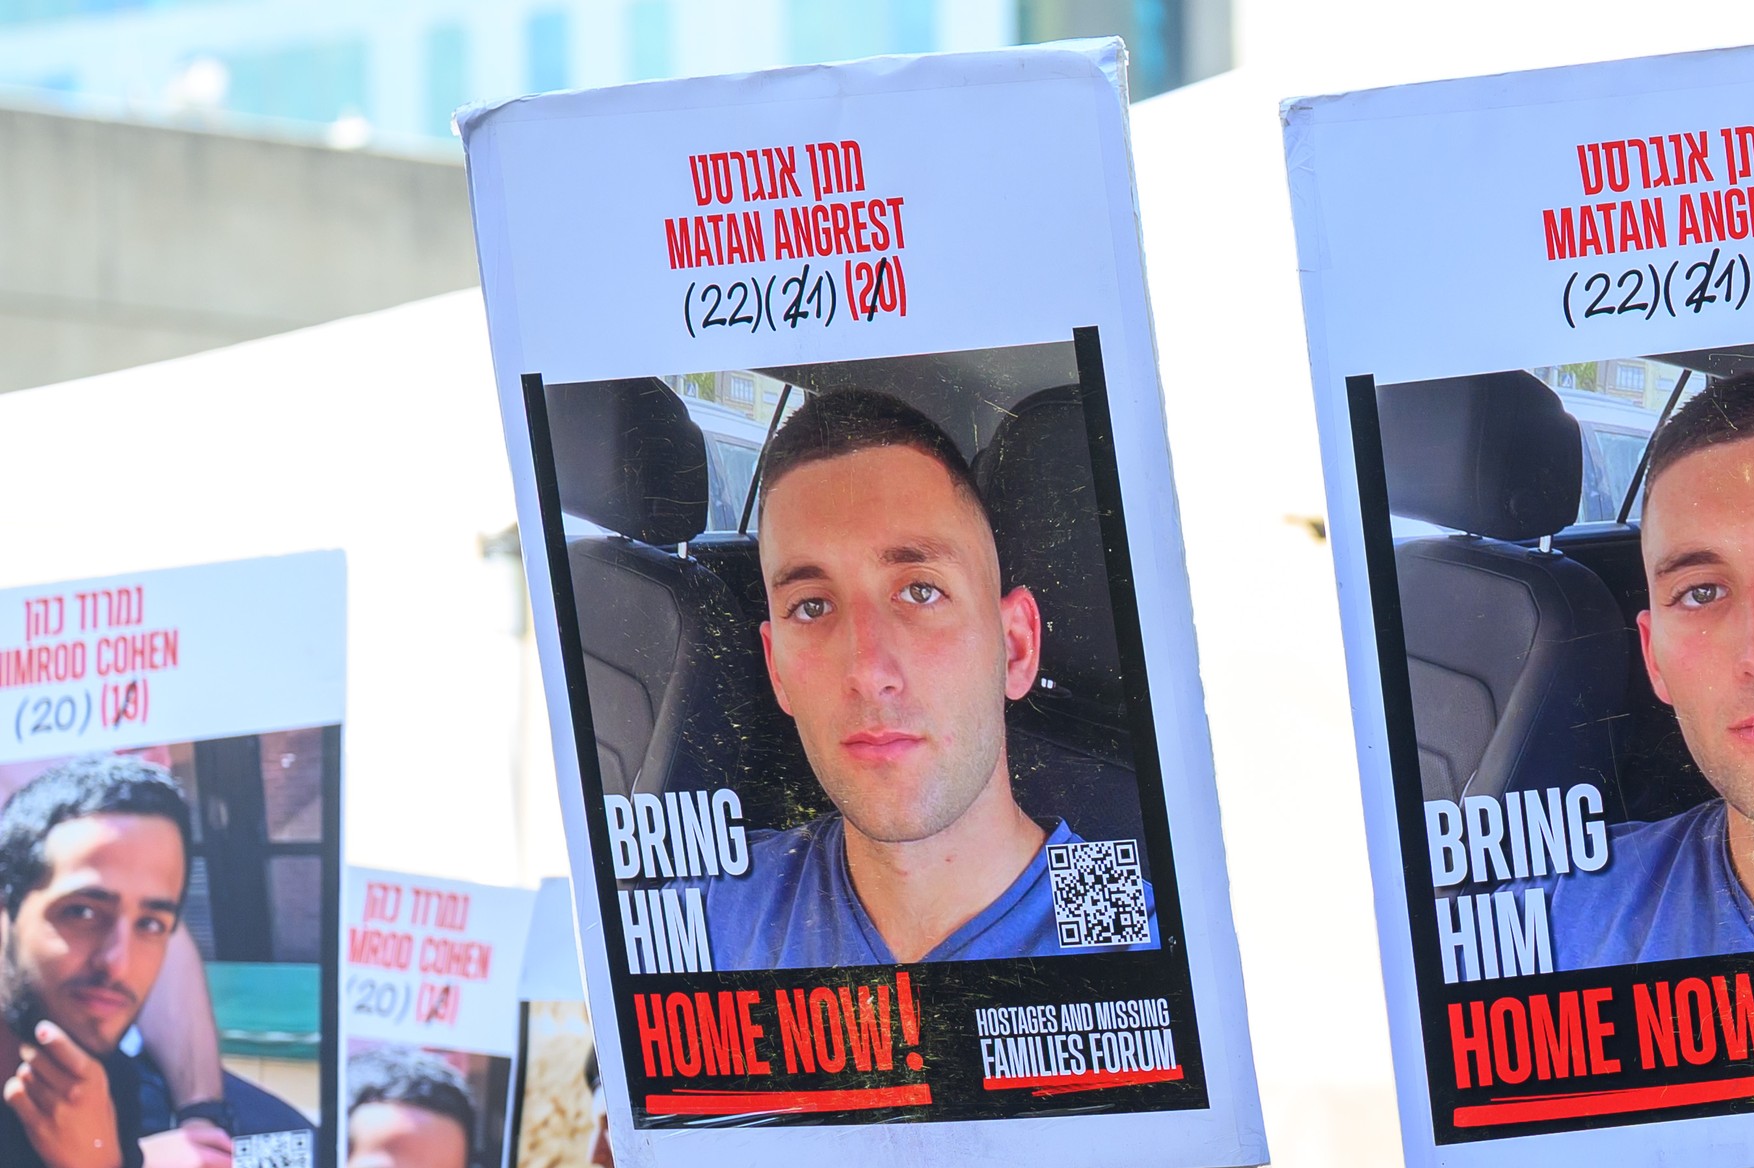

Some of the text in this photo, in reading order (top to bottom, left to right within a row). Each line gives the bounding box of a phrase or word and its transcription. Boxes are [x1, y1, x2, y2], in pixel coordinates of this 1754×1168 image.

[689, 140, 865, 206] מתן אנגרסט
[1576, 130, 1714, 195] אנגרסט
[664, 197, 905, 269] MATAN ANGREST
[1542, 197, 1667, 261] MATAN
[97, 629, 179, 677] COHEN
[15, 690, 92, 743] (20)
[603, 788, 749, 879] BRING
[1424, 783, 1608, 888] BRING
[617, 886, 712, 974] HIM
[1437, 887, 1554, 984] HIM
[634, 972, 924, 1077] HOME NOW!
[976, 998, 1169, 1037] HOSTAGES AND MISSING
[1448, 987, 1621, 1089] HOME
[980, 1028, 1177, 1079] FAMILIES FORUM
